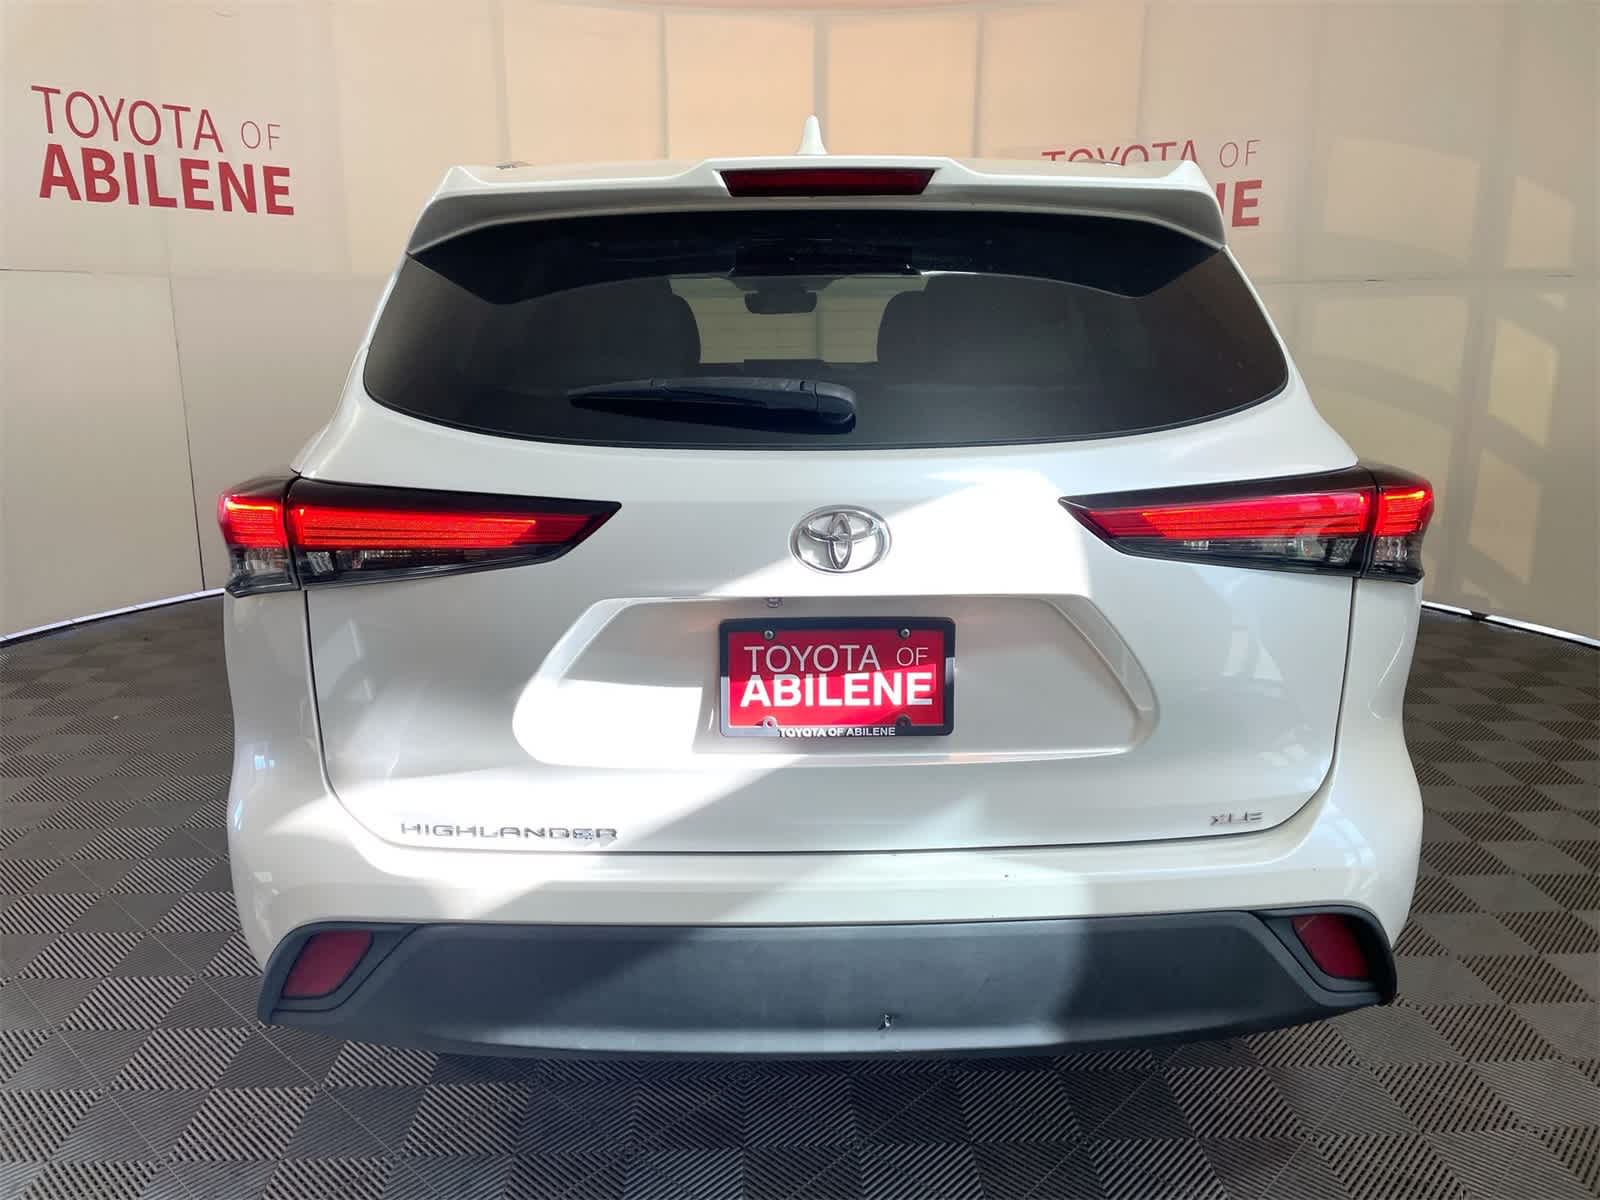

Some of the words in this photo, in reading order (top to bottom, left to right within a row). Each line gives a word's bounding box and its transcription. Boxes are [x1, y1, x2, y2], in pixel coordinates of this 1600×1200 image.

[31, 85, 223, 153] TOYOTA
[240, 120, 281, 150] OF
[1041, 139, 1199, 166] OTA
[1219, 139, 1261, 168] OF
[39, 143, 294, 216] ABILENE
[744, 645, 881, 673] TOYOTA
[896, 647, 929, 666] OF
[740, 672, 933, 707] ABILENE
[779, 727, 827, 738] TOYOTA
[828, 727, 844, 737] OF
[846, 727, 896, 737] ABILENE
[400, 822, 618, 840] HIGHLANDER
